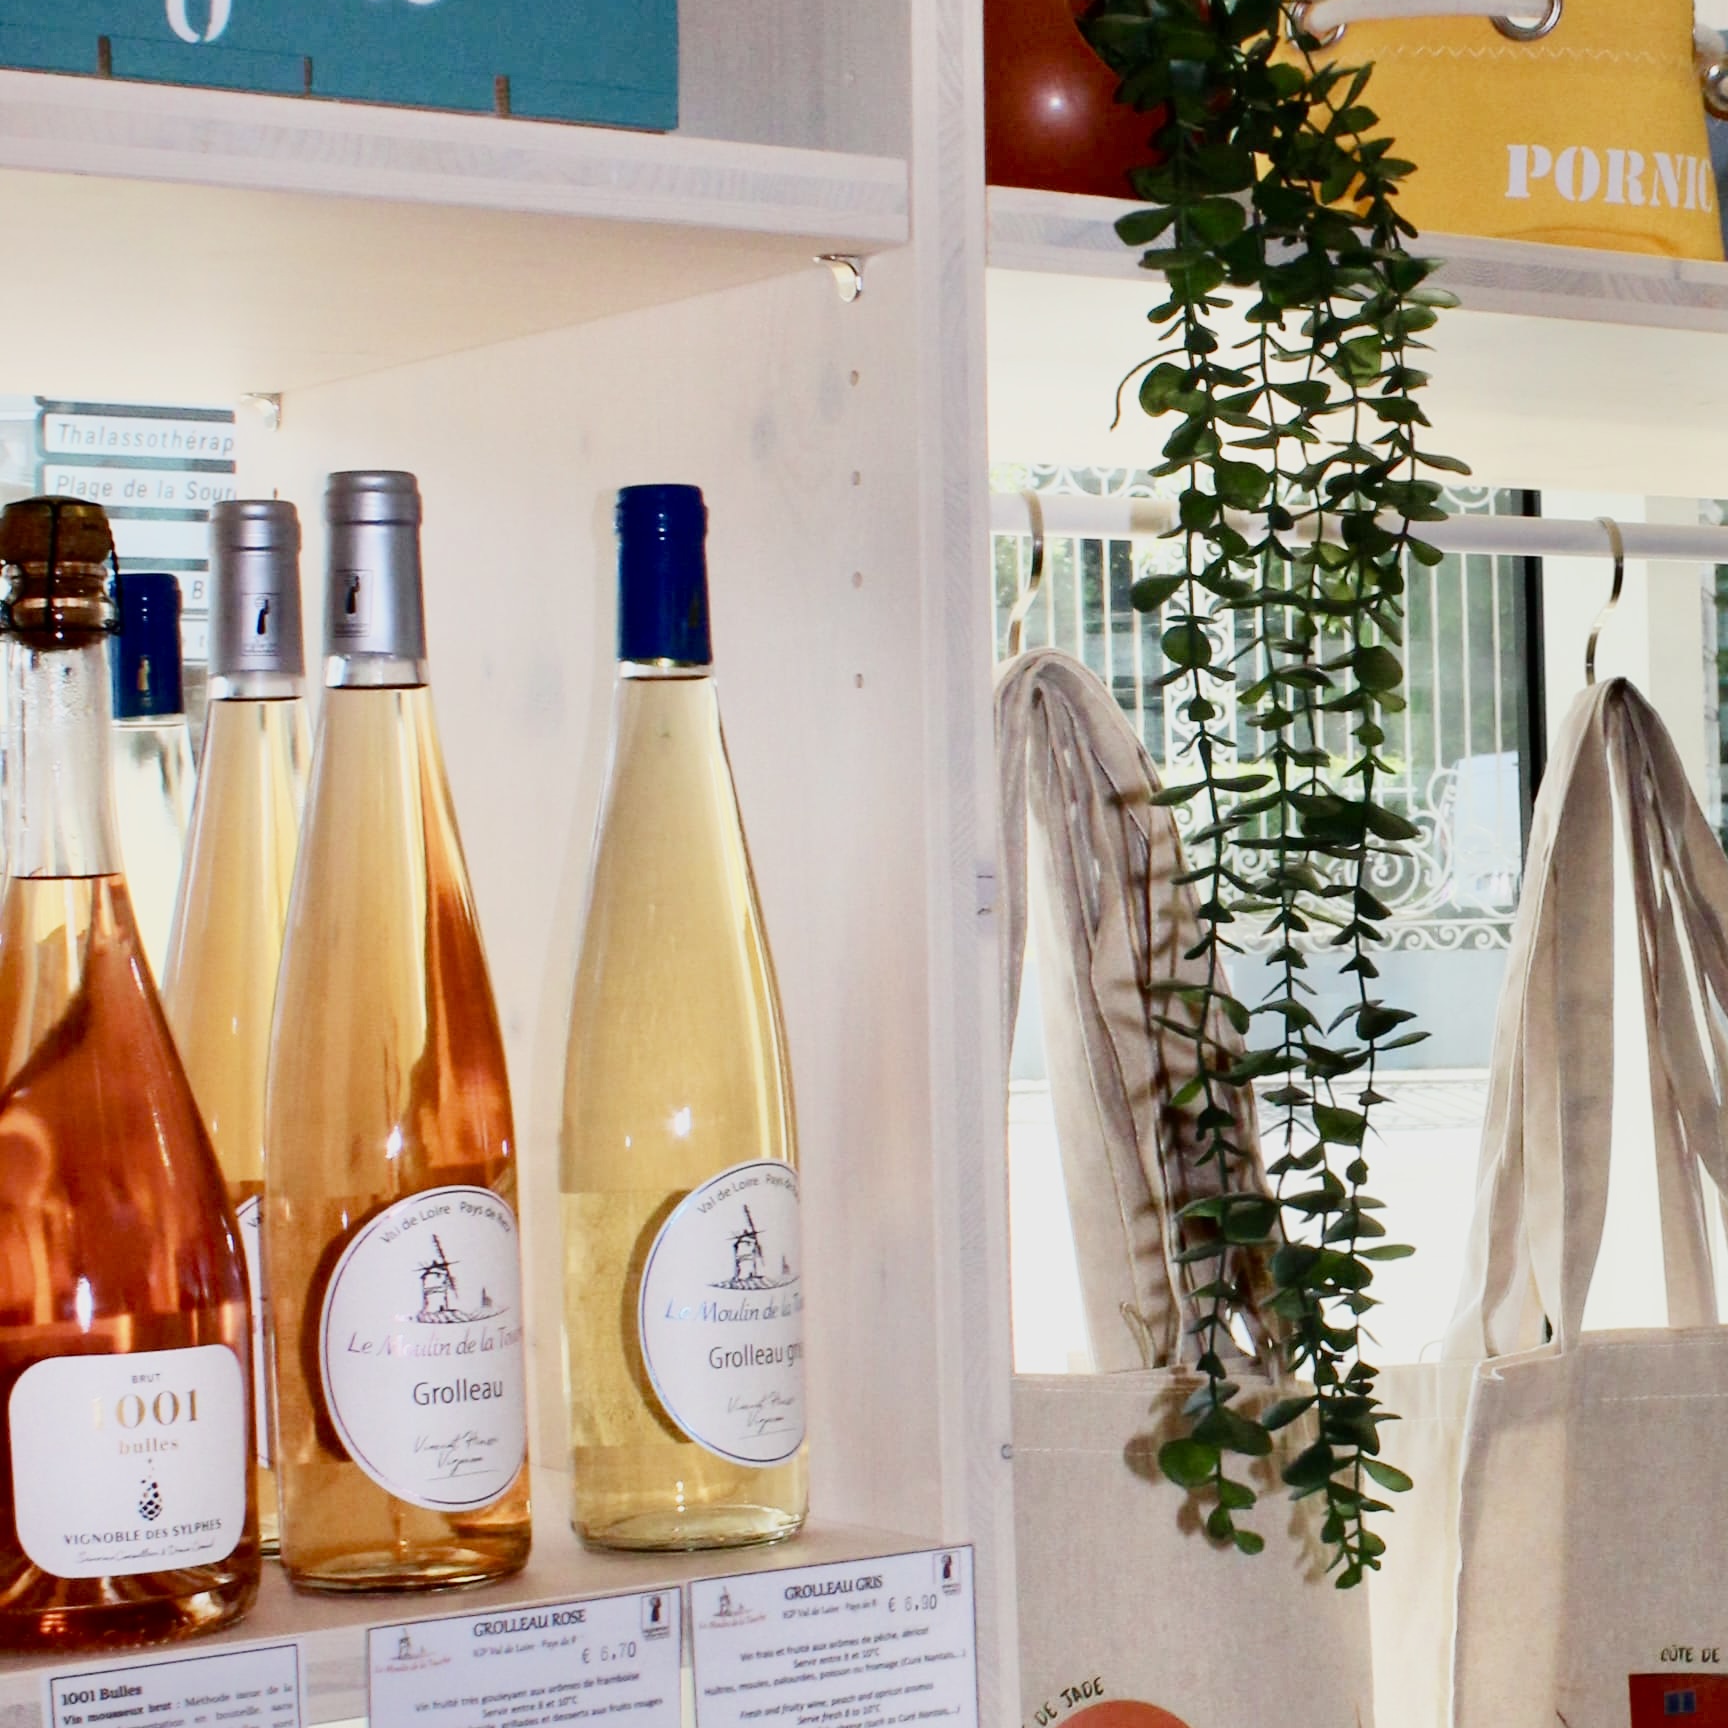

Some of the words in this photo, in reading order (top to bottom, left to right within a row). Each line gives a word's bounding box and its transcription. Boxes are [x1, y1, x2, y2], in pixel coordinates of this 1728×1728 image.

[56, 474, 113, 502] Plage
[124, 478, 147, 498] de
[158, 480, 175, 499] la
[716, 1187, 731, 1202] de
[402, 1216, 419, 1231] de
[421, 1203, 452, 1222] Loire
[459, 1200, 483, 1216] Pays
[700, 1298, 759, 1323] Moulin
[762, 1298, 777, 1321] de
[347, 1331, 373, 1355] Le
[456, 1331, 477, 1356] de
[480, 1329, 495, 1353] la
[709, 1343, 783, 1370] Grolleau
[131, 1373, 161, 1384] BRUT
[413, 1378, 504, 1407] Grolleau
[91, 1388, 199, 1431] 1001
[118, 1437, 180, 1456] bulles
[64, 1529, 141, 1546] VIGNOBLE
[145, 1525, 169, 1540] DES
[172, 1518, 223, 1537] SYLPHES
[784, 1579, 852, 1601] GROLLEAU
[855, 1575, 882, 1591] GRIS
[473, 1614, 548, 1638] GROLLEAU
[1701, 1647, 1721, 1665] DE
[61, 1690, 94, 1706] 1001
[99, 1683, 142, 1700] Bulles
[1036, 1700, 1059, 1728] DE
[1060, 1676, 1105, 1708] JADE
[62, 1714, 82, 1725] Vin
